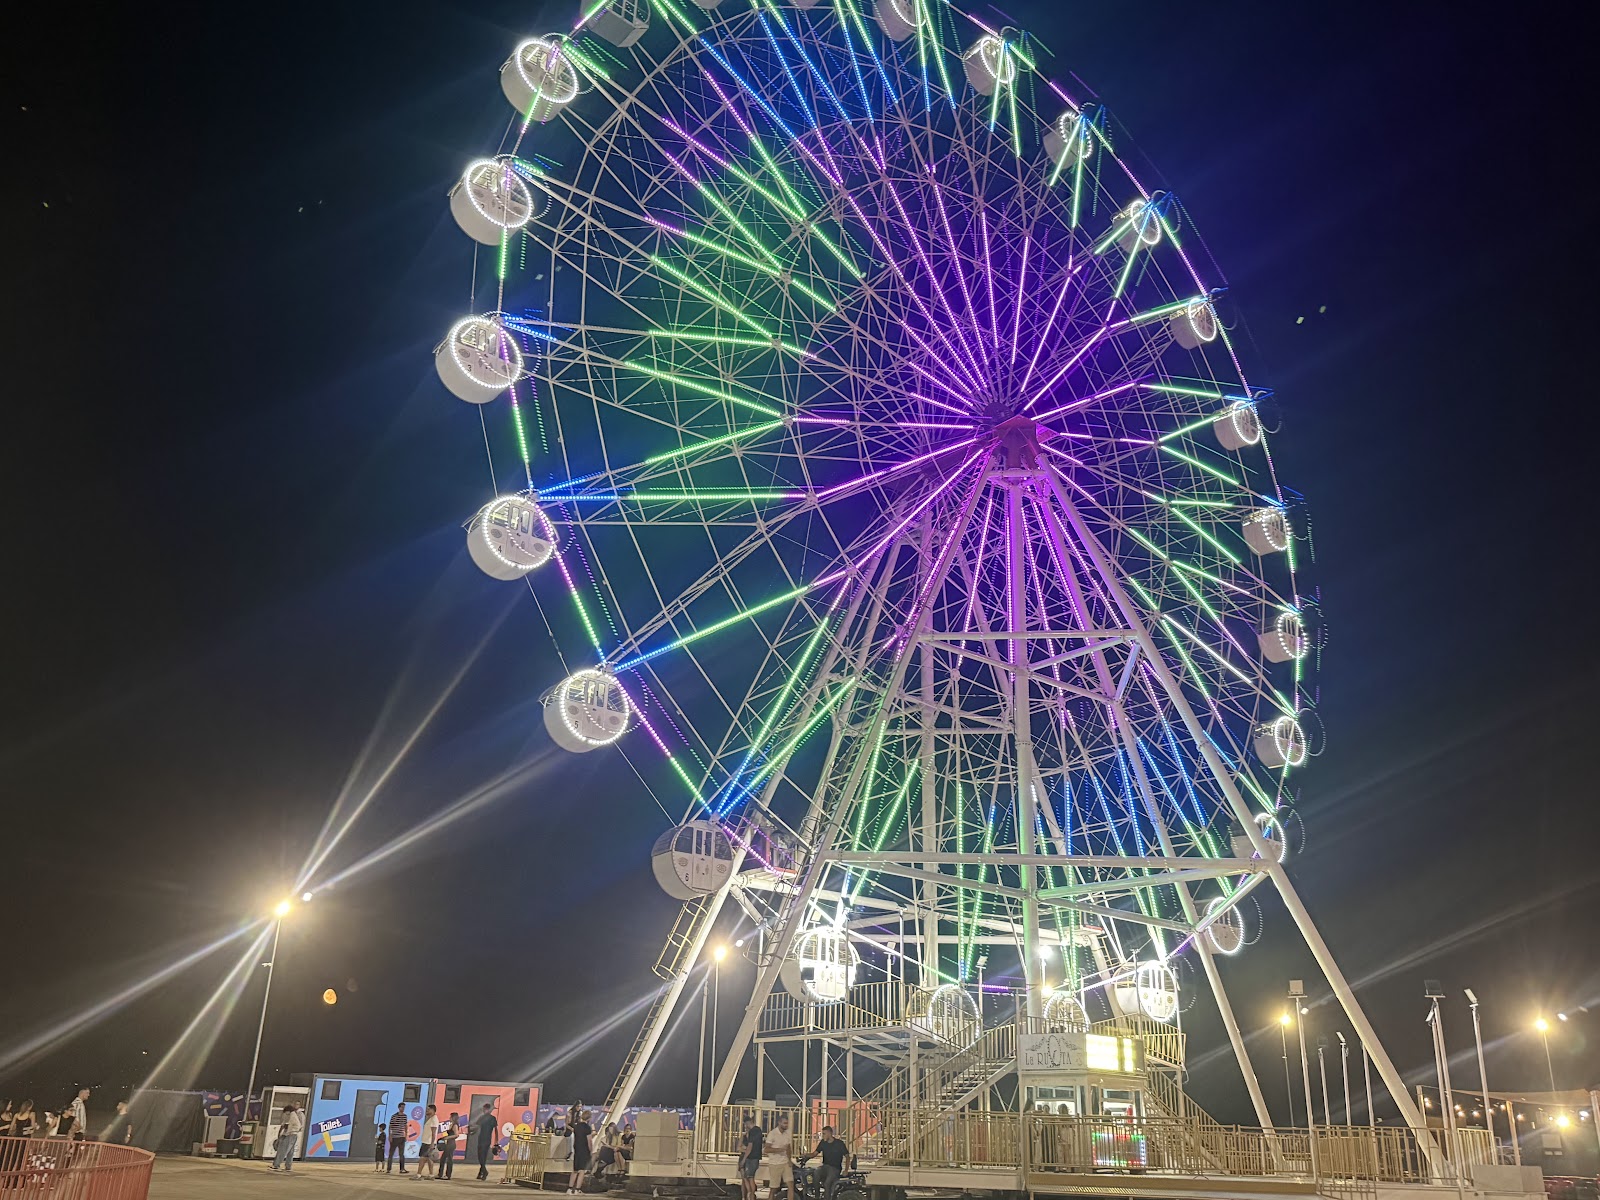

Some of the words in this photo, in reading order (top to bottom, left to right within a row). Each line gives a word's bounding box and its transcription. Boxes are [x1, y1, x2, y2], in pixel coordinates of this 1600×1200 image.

[497, 545, 502, 553] 4
[574, 720, 579, 729] 5
[1025, 1053, 1034, 1066] La
[318, 1118, 342, 1133] Toilet
